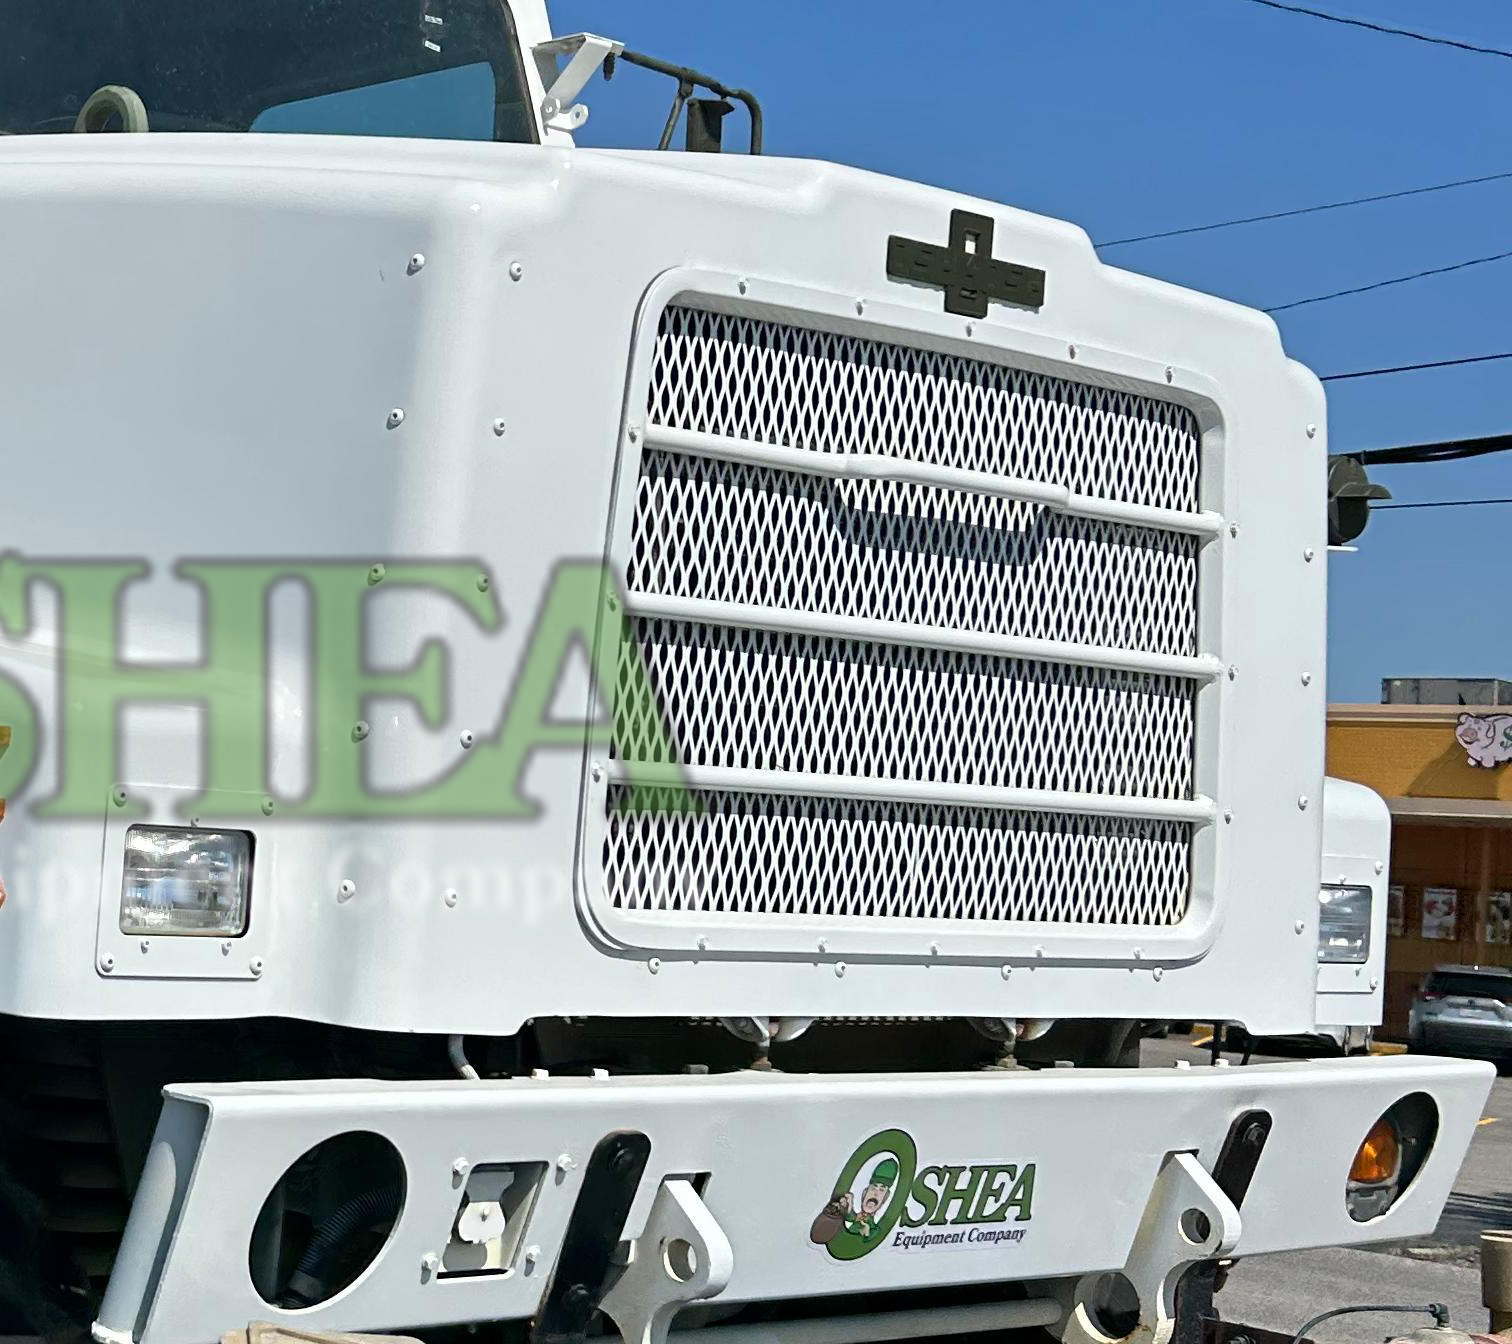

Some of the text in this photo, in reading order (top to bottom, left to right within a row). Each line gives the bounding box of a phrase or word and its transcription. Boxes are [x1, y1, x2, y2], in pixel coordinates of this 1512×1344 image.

[825, 1128, 1036, 1260] OSHEA
[892, 1227, 1027, 1249] Equipment Company
